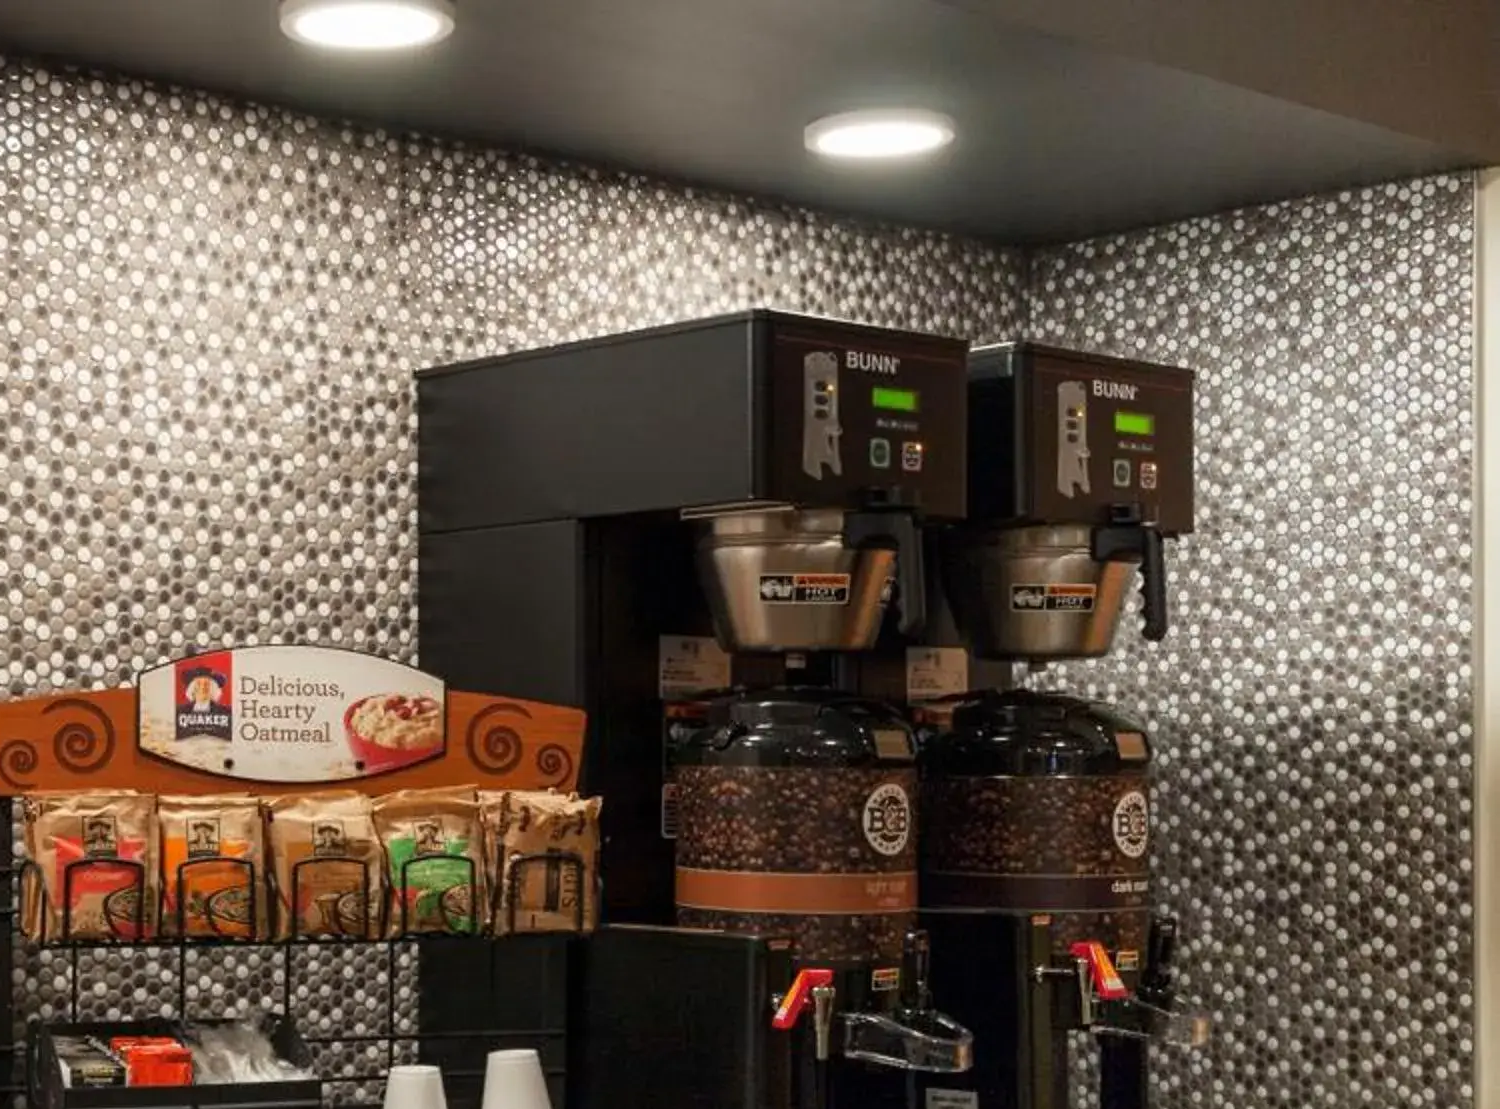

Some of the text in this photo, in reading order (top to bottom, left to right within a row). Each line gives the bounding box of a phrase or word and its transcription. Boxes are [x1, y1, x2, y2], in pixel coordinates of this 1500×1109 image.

[845, 351, 898, 375] BUNN
[1093, 380, 1136, 400] BUNN
[240, 675, 345, 700] Delicious,
[179, 713, 229, 728] QUAKER
[240, 701, 316, 723] Hearty
[240, 723, 332, 743] Oatmeal
